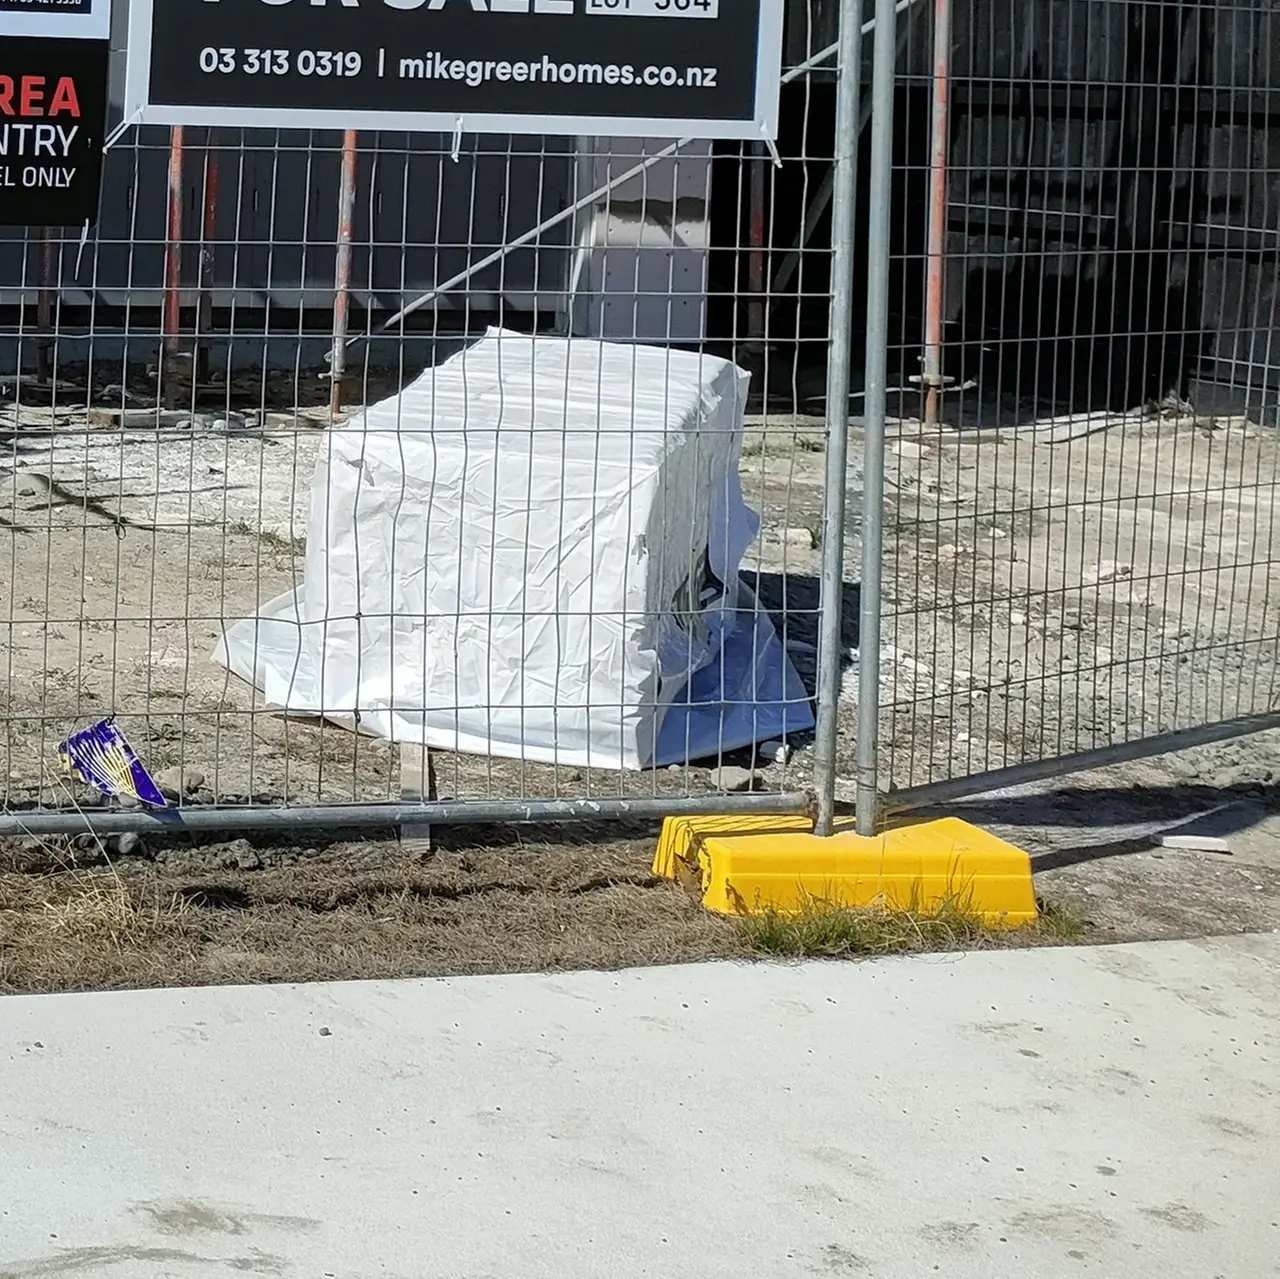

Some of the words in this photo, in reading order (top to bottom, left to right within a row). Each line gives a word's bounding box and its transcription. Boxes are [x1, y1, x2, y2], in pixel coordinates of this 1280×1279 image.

[199, 47, 236, 74] 03
[243, 49, 289, 75] 313
[297, 50, 361, 77] 0319
[399, 50, 717, 88] mikegreerhomes.co.nz
[22, 167, 76, 187] ONLY
